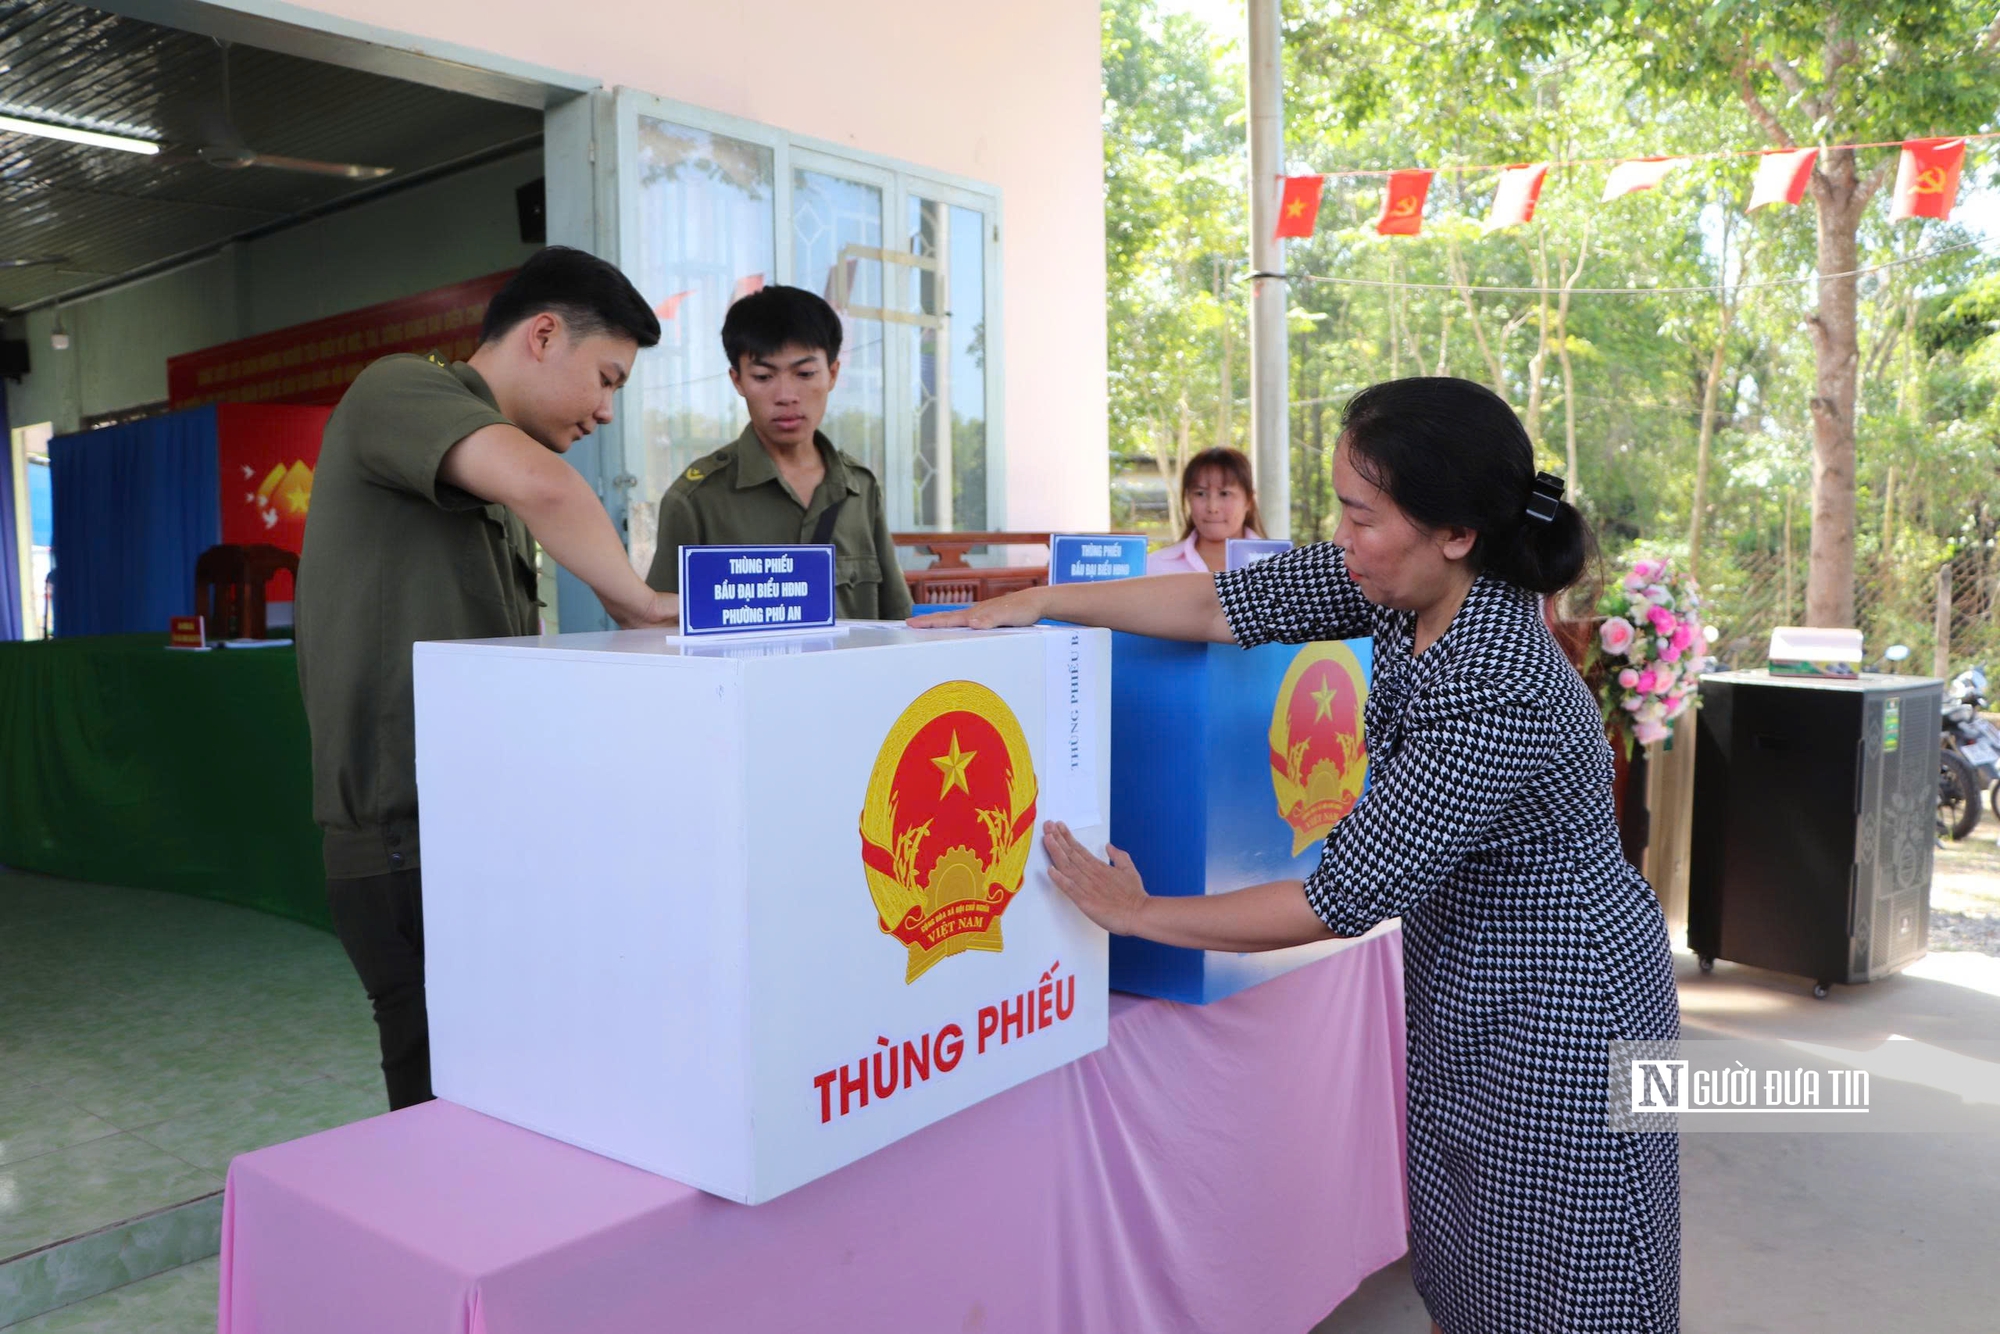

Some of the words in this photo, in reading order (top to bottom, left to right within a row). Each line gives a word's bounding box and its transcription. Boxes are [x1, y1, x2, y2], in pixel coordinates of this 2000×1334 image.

[729, 556, 763, 574] THÙNG
[765, 553, 794, 573] PHIẾU
[714, 579, 735, 600] BẦU
[738, 584, 754, 601] ĐẠI
[757, 577, 780, 598] BIỂU
[781, 581, 808, 597] HĐND
[722, 605, 764, 625] PHƯỜNG
[765, 604, 786, 622] PHÚ
[787, 606, 802, 621] AN
[1067, 650, 1079, 704] PHIẾU
[1069, 709, 1079, 771] THÙNG
[927, 921, 955, 942] VIỆT
[958, 916, 984, 930] NAM
[814, 1023, 964, 1124] THÙNG
[978, 959, 1075, 1054] PHIẾU
